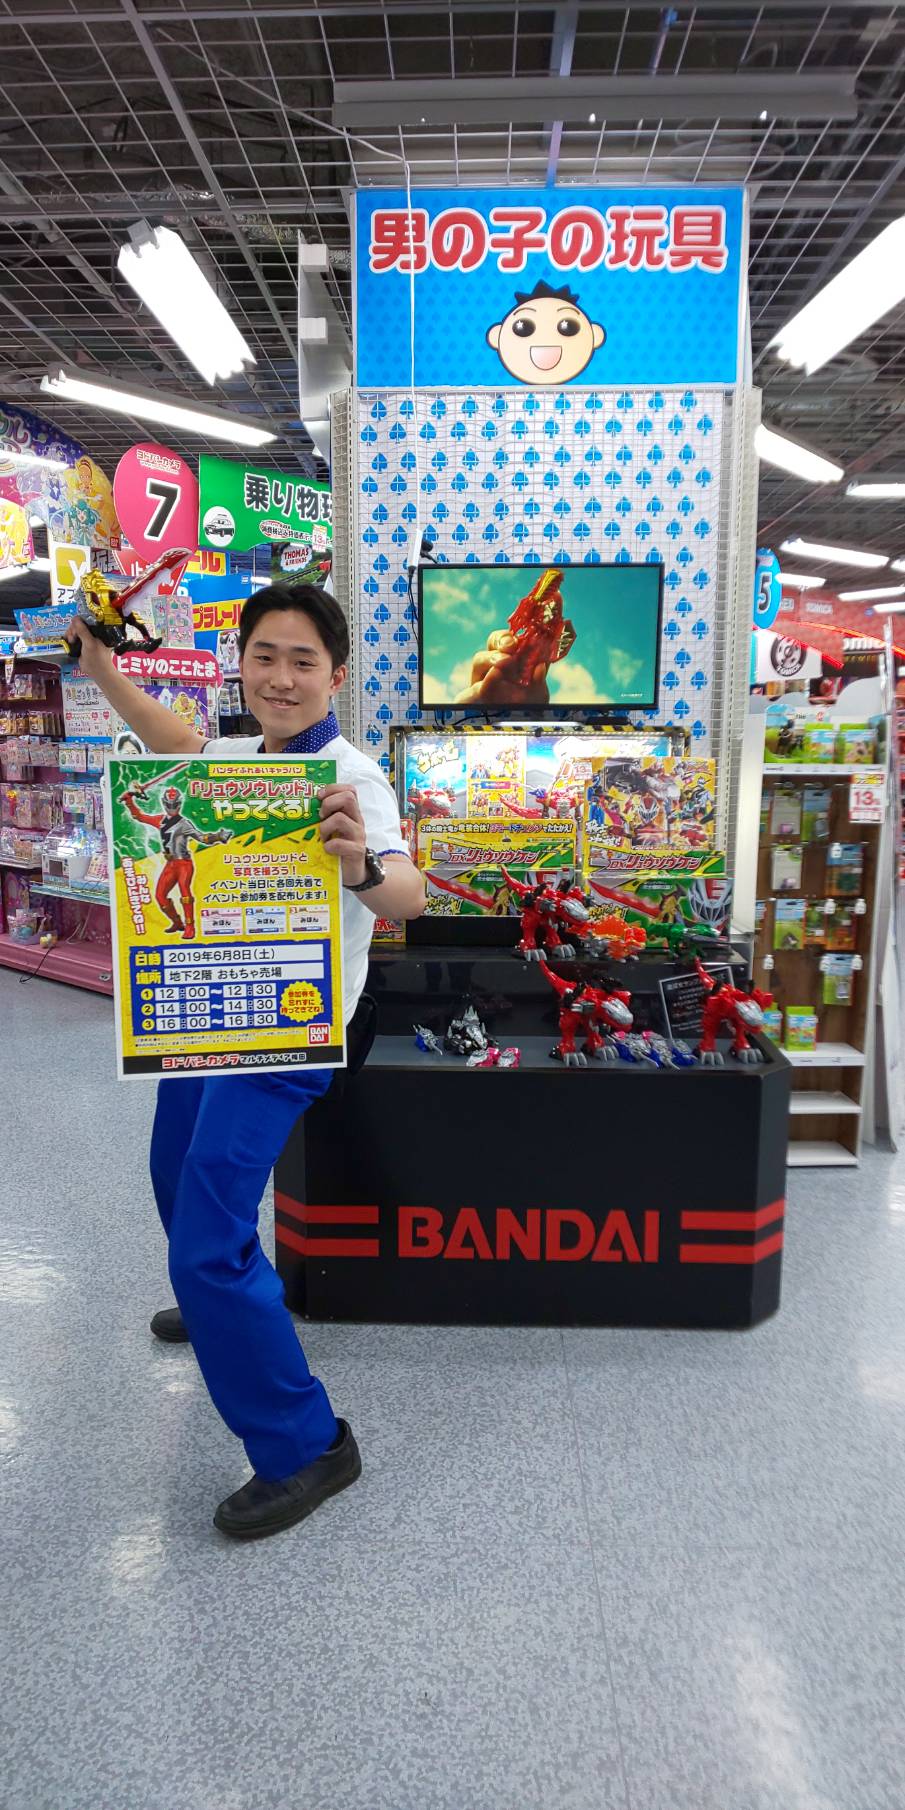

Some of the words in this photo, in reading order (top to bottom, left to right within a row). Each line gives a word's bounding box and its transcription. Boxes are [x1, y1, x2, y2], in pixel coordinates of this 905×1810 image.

[371, 206, 726, 271] 男の子の玩具
[145, 479, 180, 541] 7
[284, 548, 309, 560] THOMAS
[757, 572, 772, 614] 5
[117, 656, 216, 677] ヒミツのここたま
[212, 799, 312, 820] やってくる!
[224, 853, 308, 865] リュウソウレッドと
[450, 848, 540, 865] DXリュウソウケン
[609, 855, 702, 871] DXリュウソウケン
[170, 970, 213, 982] 地下2階
[217, 967, 282, 980] おもちゃ売場
[398, 1206, 659, 1263] BANDAI
